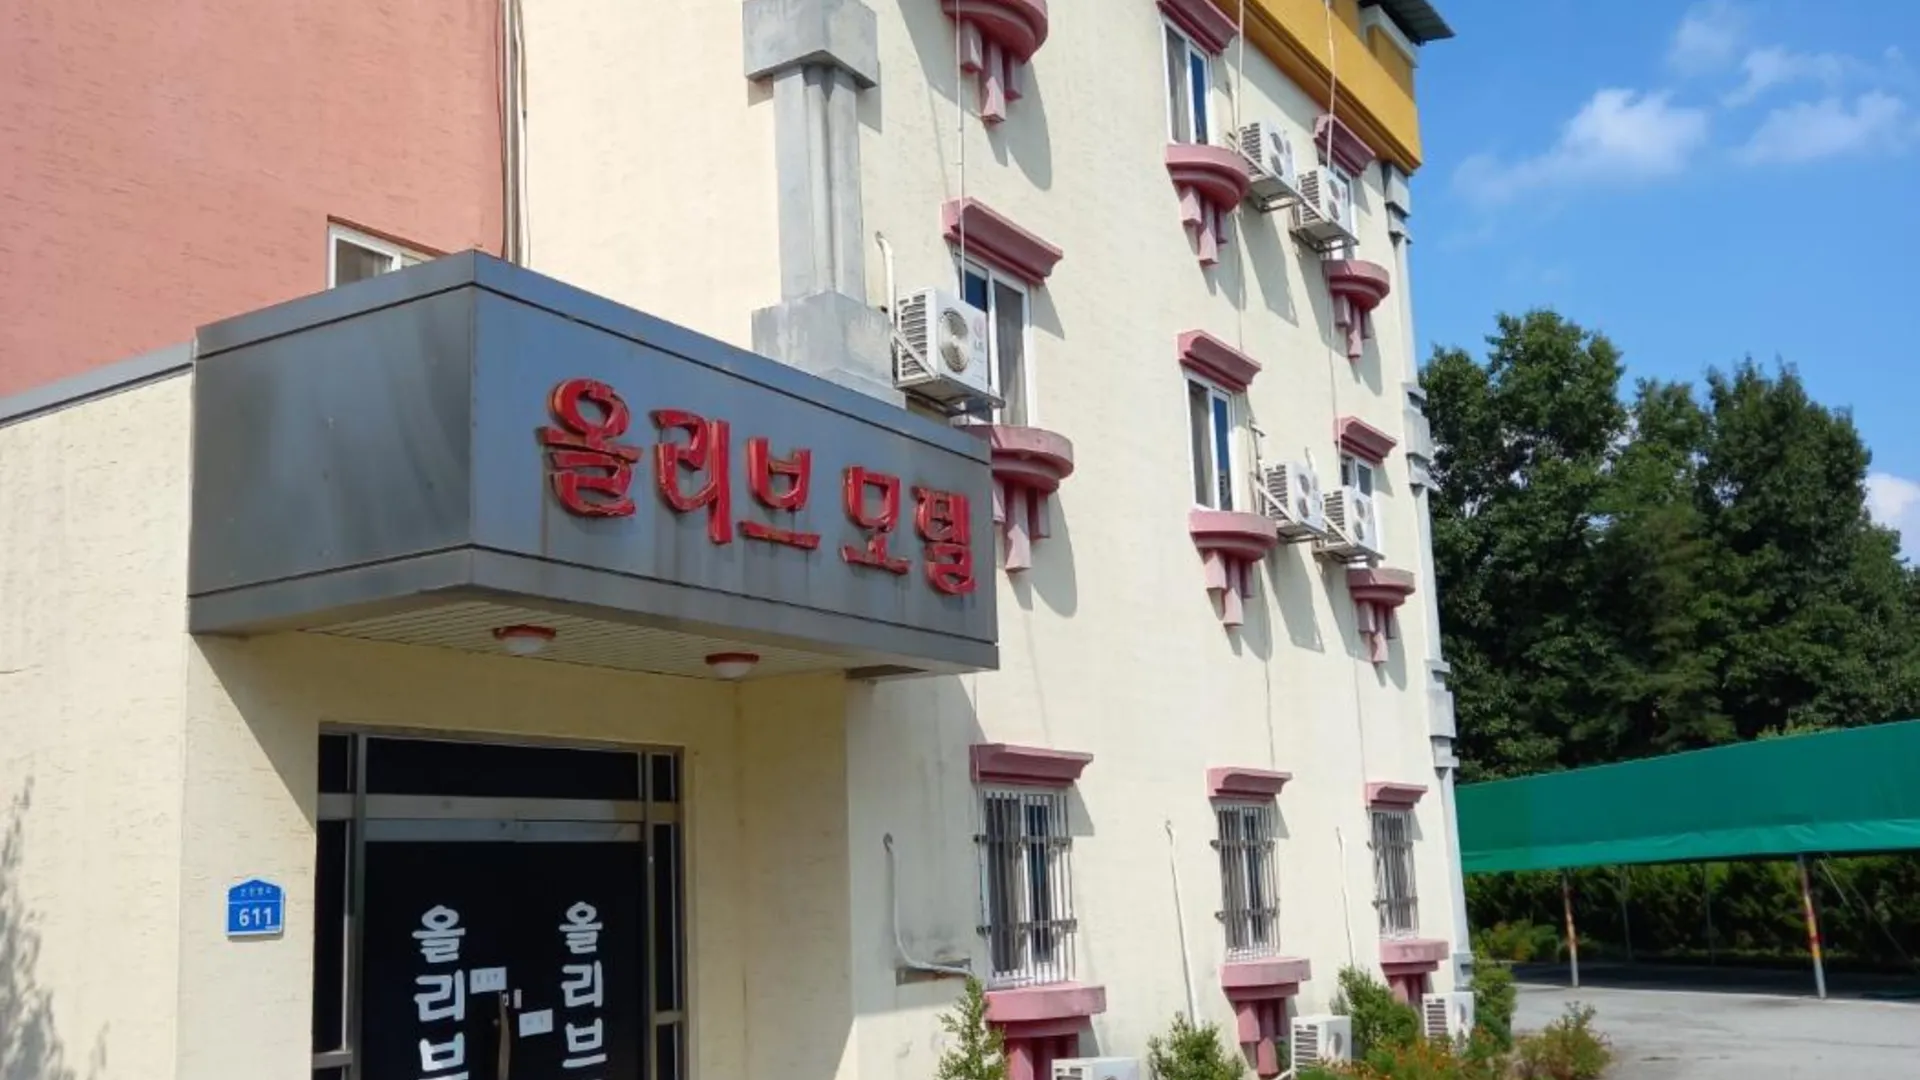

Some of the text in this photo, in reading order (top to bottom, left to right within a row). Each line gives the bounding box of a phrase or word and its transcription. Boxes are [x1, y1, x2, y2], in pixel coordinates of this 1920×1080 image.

[538, 378, 977, 595] 올리브 모텔
[239, 908, 272, 927] 611
[558, 901, 608, 1069] 올리브
